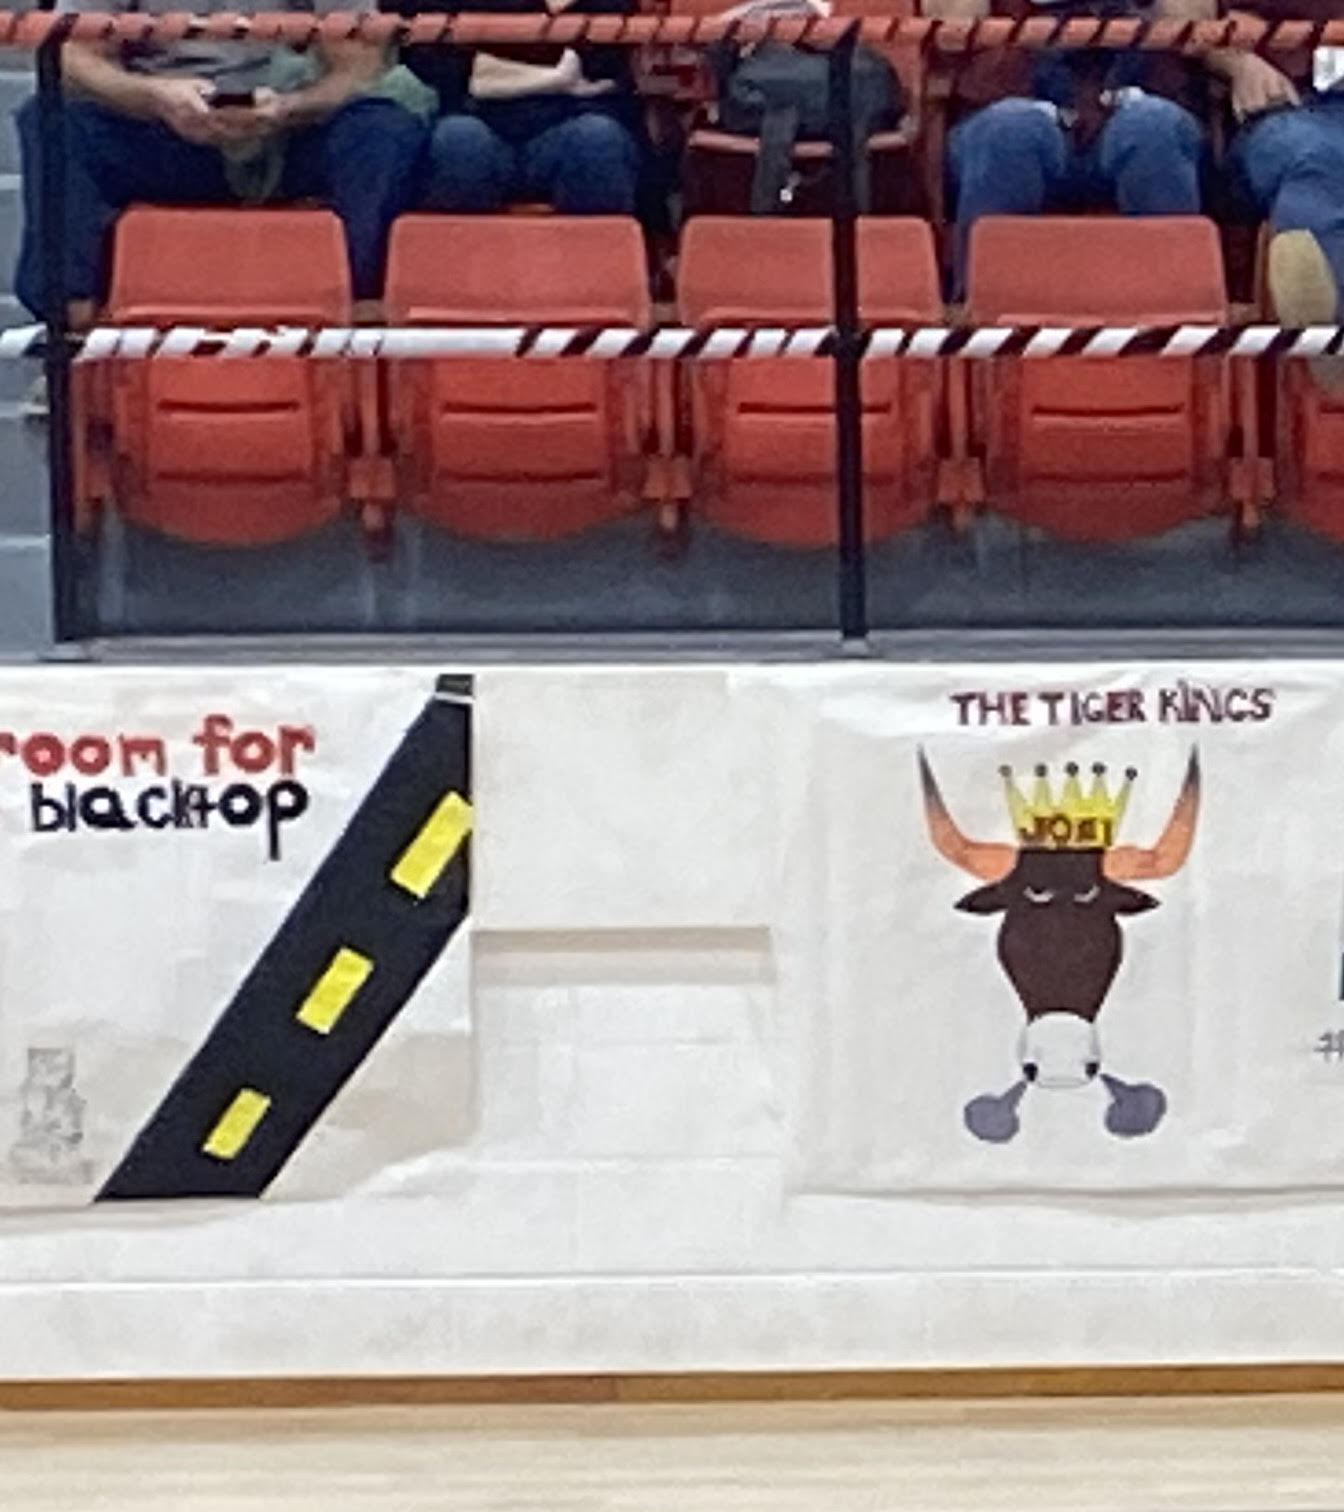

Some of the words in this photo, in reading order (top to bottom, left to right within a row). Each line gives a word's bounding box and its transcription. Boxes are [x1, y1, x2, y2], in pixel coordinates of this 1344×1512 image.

[949, 691, 1032, 725] THE
[1037, 690, 1147, 725] TIGER
[1159, 680, 1275, 724] KINGS
[190, 713, 316, 777] for
[30, 777, 310, 861] blacktop
